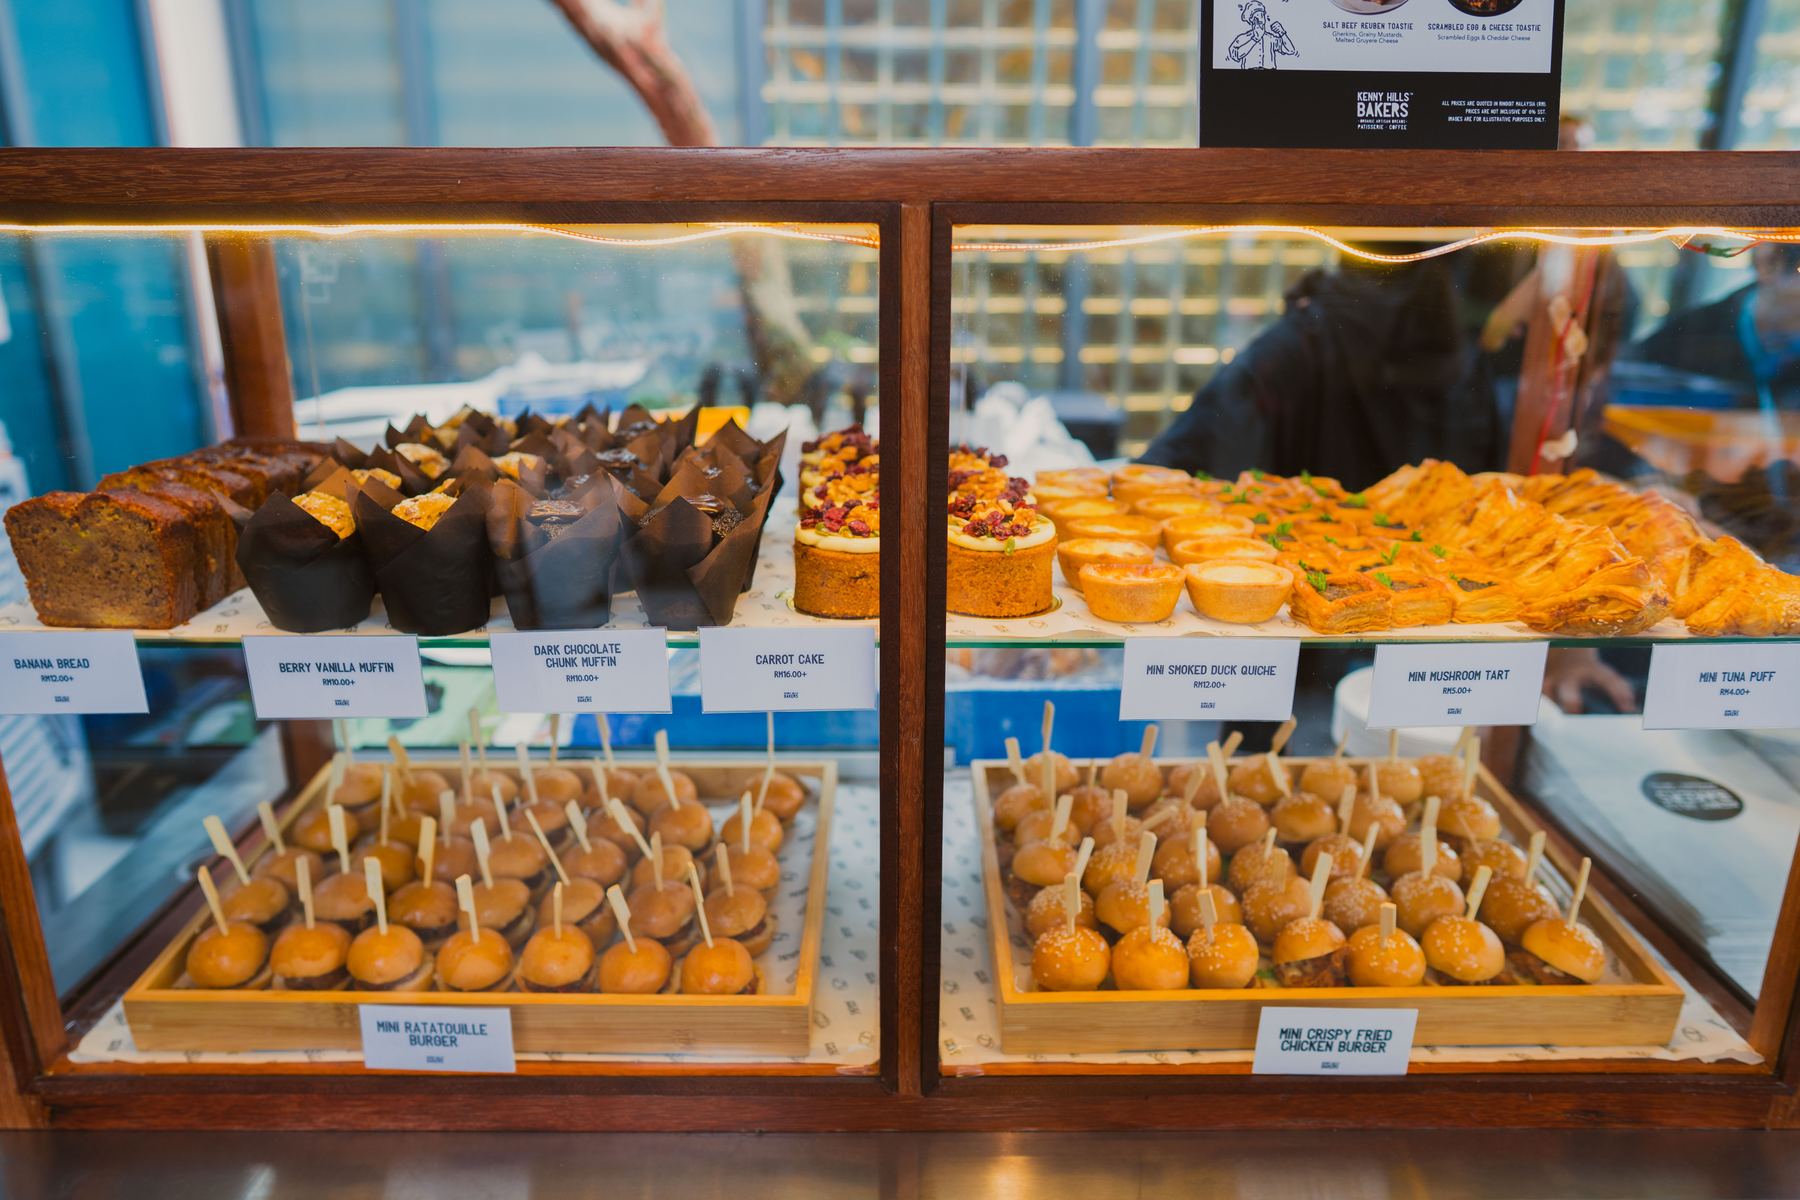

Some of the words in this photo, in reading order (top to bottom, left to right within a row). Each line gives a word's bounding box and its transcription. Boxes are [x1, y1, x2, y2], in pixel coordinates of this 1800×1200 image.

[1322, 21, 1339, 29] SALT
[1342, 21, 1358, 29] BEEF
[1360, 22, 1385, 30] REUBEN
[1388, 22, 1414, 30] TOASTIE
[1427, 23, 1464, 31] SCRAMBLED
[1516, 24, 1541, 32] TOASTIE
[1466, 34, 1480, 42] Eggs
[1357, 92, 1384, 101] KENNY
[1357, 102, 1409, 118] BAKERS
[533, 644, 560, 655] DARK
[563, 643, 621, 655] CHOCOLATE
[13, 658, 54, 670] BANANA
[56, 658, 90, 669] BREAD
[545, 656, 579, 668] CHUNK
[581, 656, 617, 667] MUFFIN
[755, 654, 794, 665] CARROT
[798, 653, 825, 664] CAKE
[278, 662, 312, 673] BERRY
[315, 662, 356, 673] VANILLA
[359, 662, 395, 673] MUFFIN
[1146, 664, 1164, 675] MINI
[1168, 664, 1207, 675] SMOKED
[1211, 664, 1237, 676] DUCK
[1241, 665, 1277, 676] QUICHE
[40, 674, 75, 683] RM12.00+
[565, 674, 599, 682] RM10.00+
[773, 670, 808, 678] RM16.00+
[1408, 670, 1427, 682] MINI
[1430, 670, 1482, 681] MUSHROOM
[1485, 669, 1511, 681] TART
[1698, 672, 1718, 682] MINI
[1722, 671, 1745, 682] TUNA
[1749, 671, 1776, 682] PUFF
[322, 678, 356, 686] RM10.00+
[1193, 681, 1226, 689] RM12.00+
[1442, 686, 1472, 695] RM5.00+
[1719, 688, 1750, 696] RM4.00+
[376, 1020, 400, 1033] MINI
[404, 1021, 488, 1036] RATATOUILLE
[1279, 1027, 1302, 1040] MINI
[1306, 1028, 1352, 1040] CRISPY
[1356, 1029, 1393, 1041] FRIED
[409, 1034, 458, 1047] BURGER
[1280, 1040, 1334, 1052] CHICKEN
[1337, 1040, 1387, 1053] BURGER
